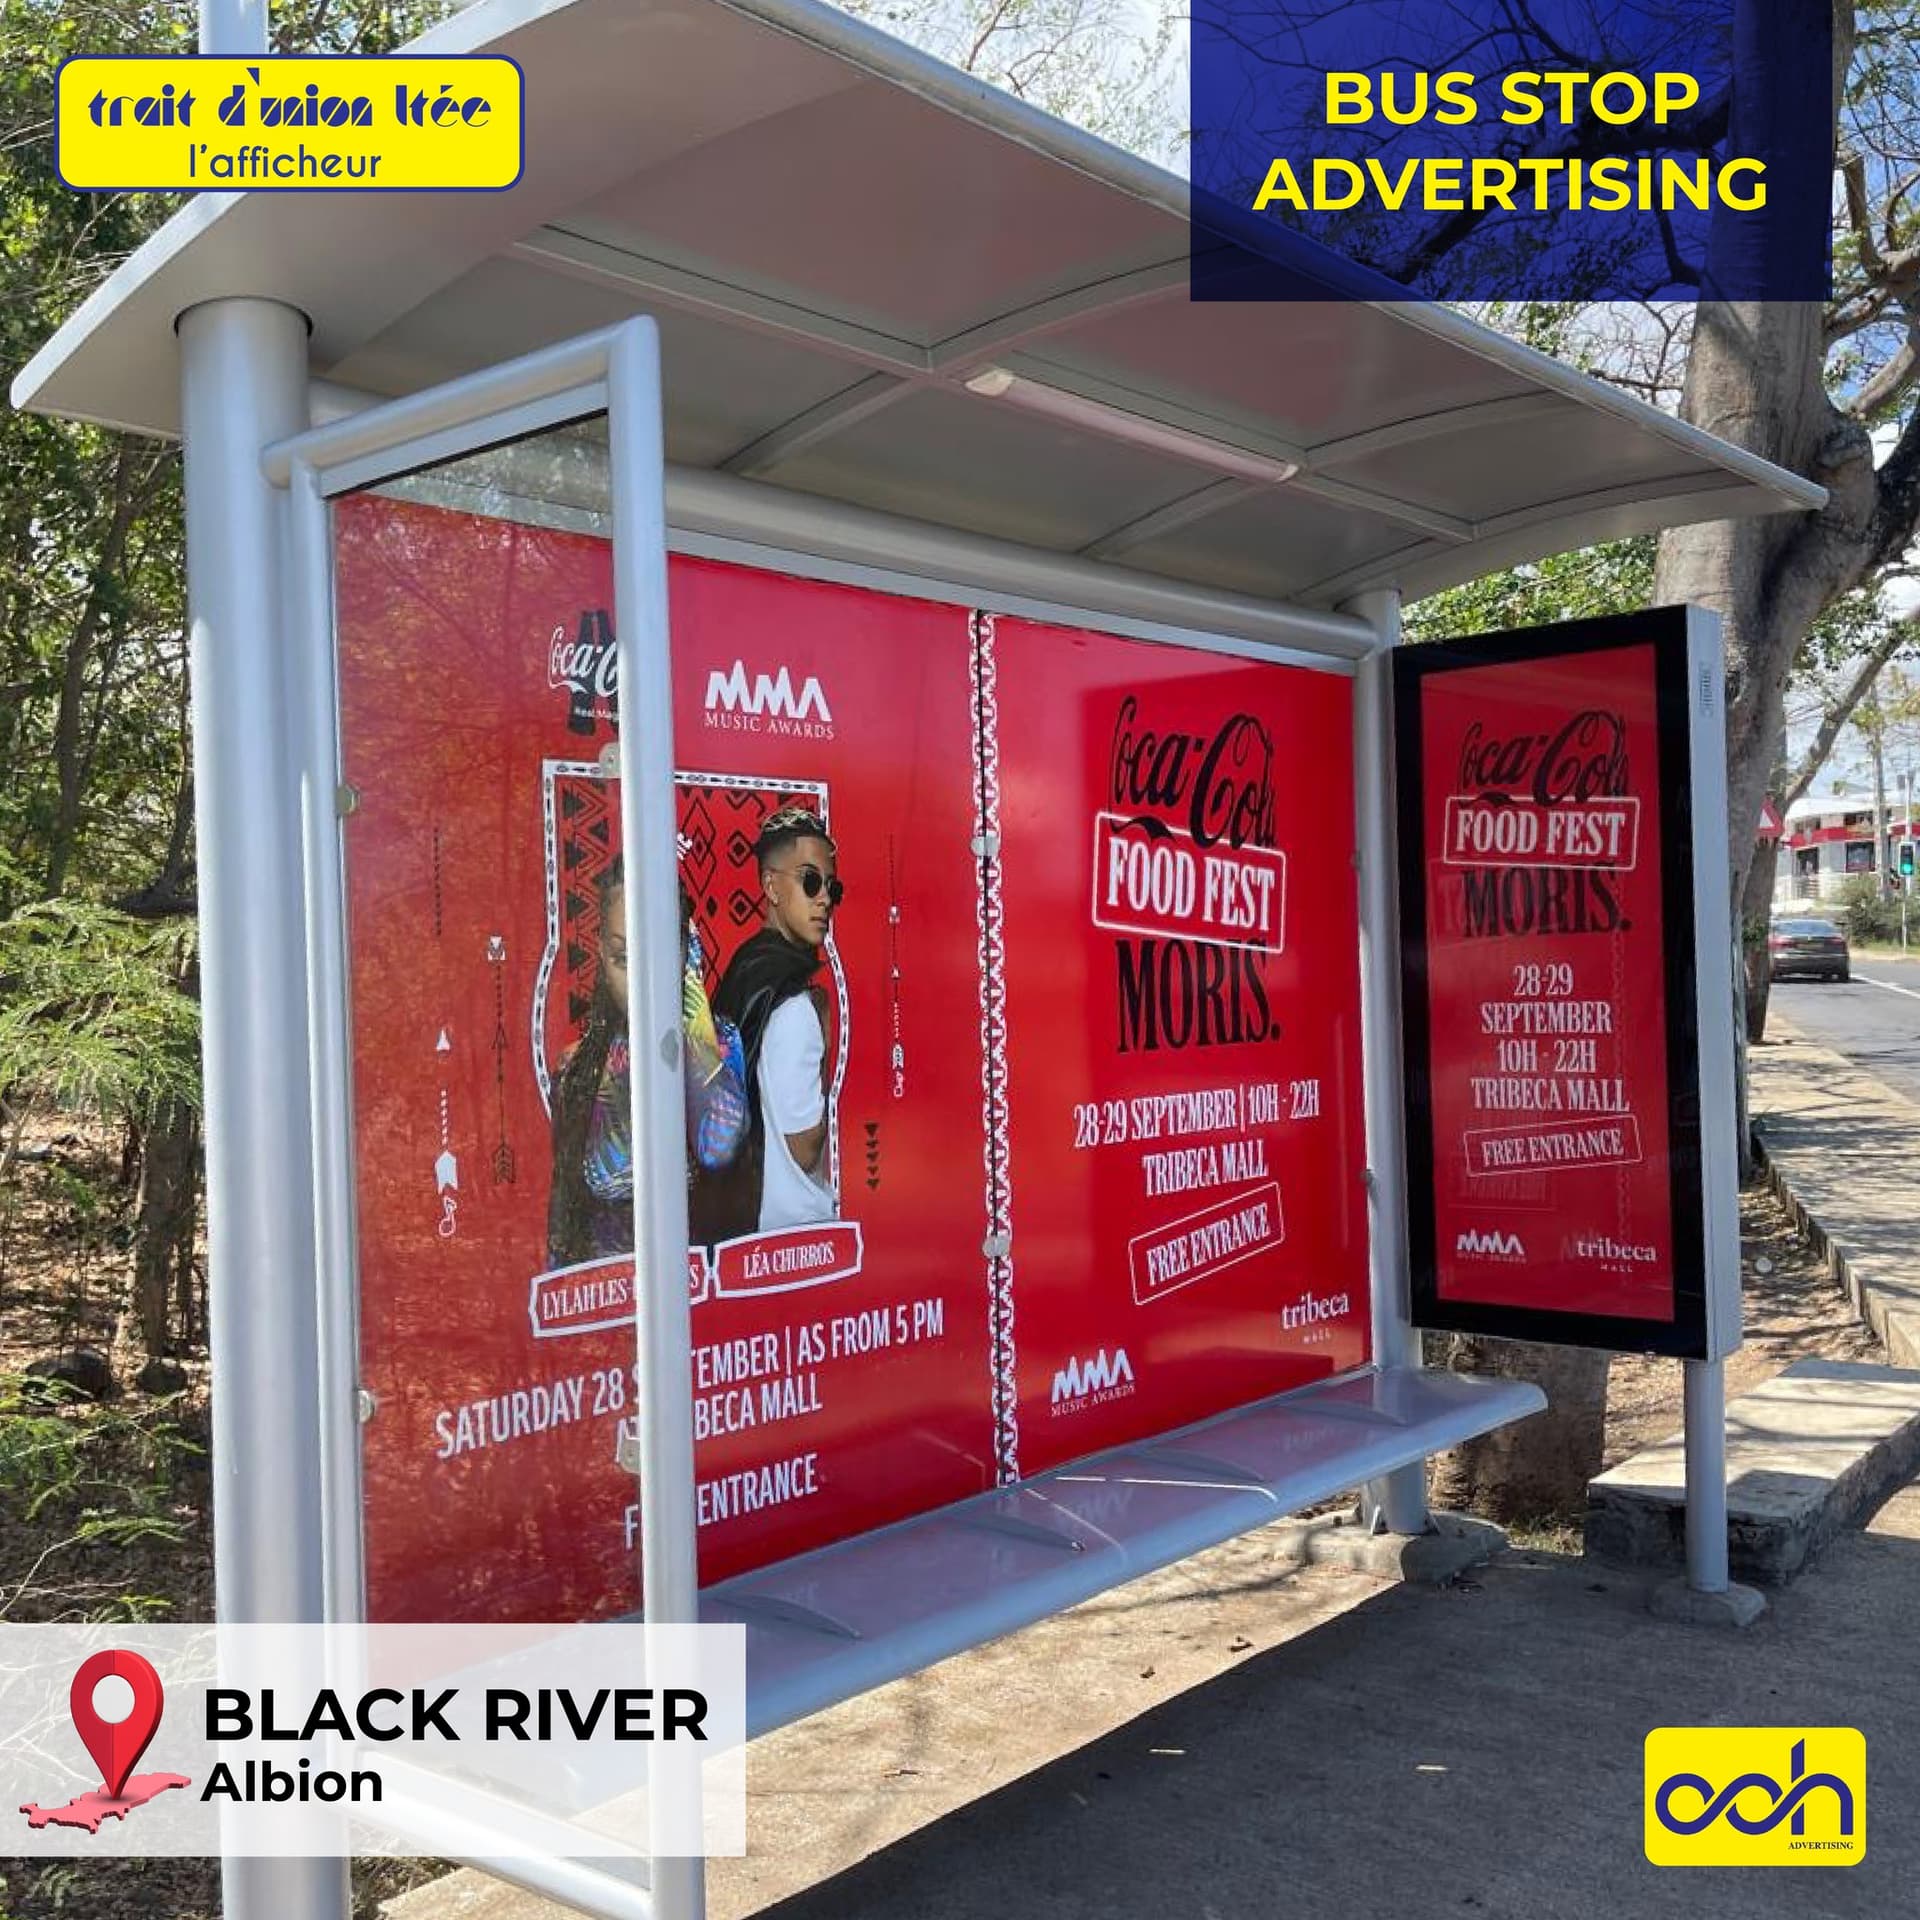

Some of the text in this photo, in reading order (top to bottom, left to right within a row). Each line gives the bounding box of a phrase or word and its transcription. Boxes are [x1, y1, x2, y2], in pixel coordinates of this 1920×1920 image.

[548, 625, 619, 697] Coca-C
[704, 711, 835, 741] MUSIC AWARDS
[1109, 695, 1278, 850] Coca-Cola
[1457, 710, 1630, 808] Coca-Cola
[1456, 809, 1626, 857] FOOD FEST
[1106, 836, 1275, 932] FOOD FEST
[1514, 963, 1575, 997] 28-29
[1481, 1001, 1613, 1034] SEPTEMBER
[1497, 1039, 1538, 1073] 10H
[1554, 1039, 1597, 1073] 22H
[1073, 1100, 1127, 1148] 28-29
[1131, 1088, 1237, 1140] SEPTEMBER
[1248, 1084, 1279, 1124] 10H
[1290, 1079, 1321, 1119] 22H
[1471, 1078, 1630, 1113] TRIBECA MALL
[1142, 1139, 1269, 1197] TRIBECA MALL
[1481, 1129, 1625, 1168] FREE ENTRANCE
[743, 1241, 835, 1279] LÉA CHURROS
[1147, 1203, 1271, 1286] FREE ENTRANCE
[1577, 1237, 1657, 1262] tribeca
[1282, 1291, 1350, 1330] tribeca
[435, 1376, 585, 1459] SATURDAY
[592, 1368, 625, 1417] 28
[797, 1322, 826, 1366] AS
[831, 1308, 891, 1359] FROM
[896, 1305, 908, 1345] 5
[913, 1297, 943, 1341] PM
[693, 1387, 755, 1441] BECA
[761, 1372, 823, 1421] MALL
[697, 1453, 818, 1527] ENTRANCE
